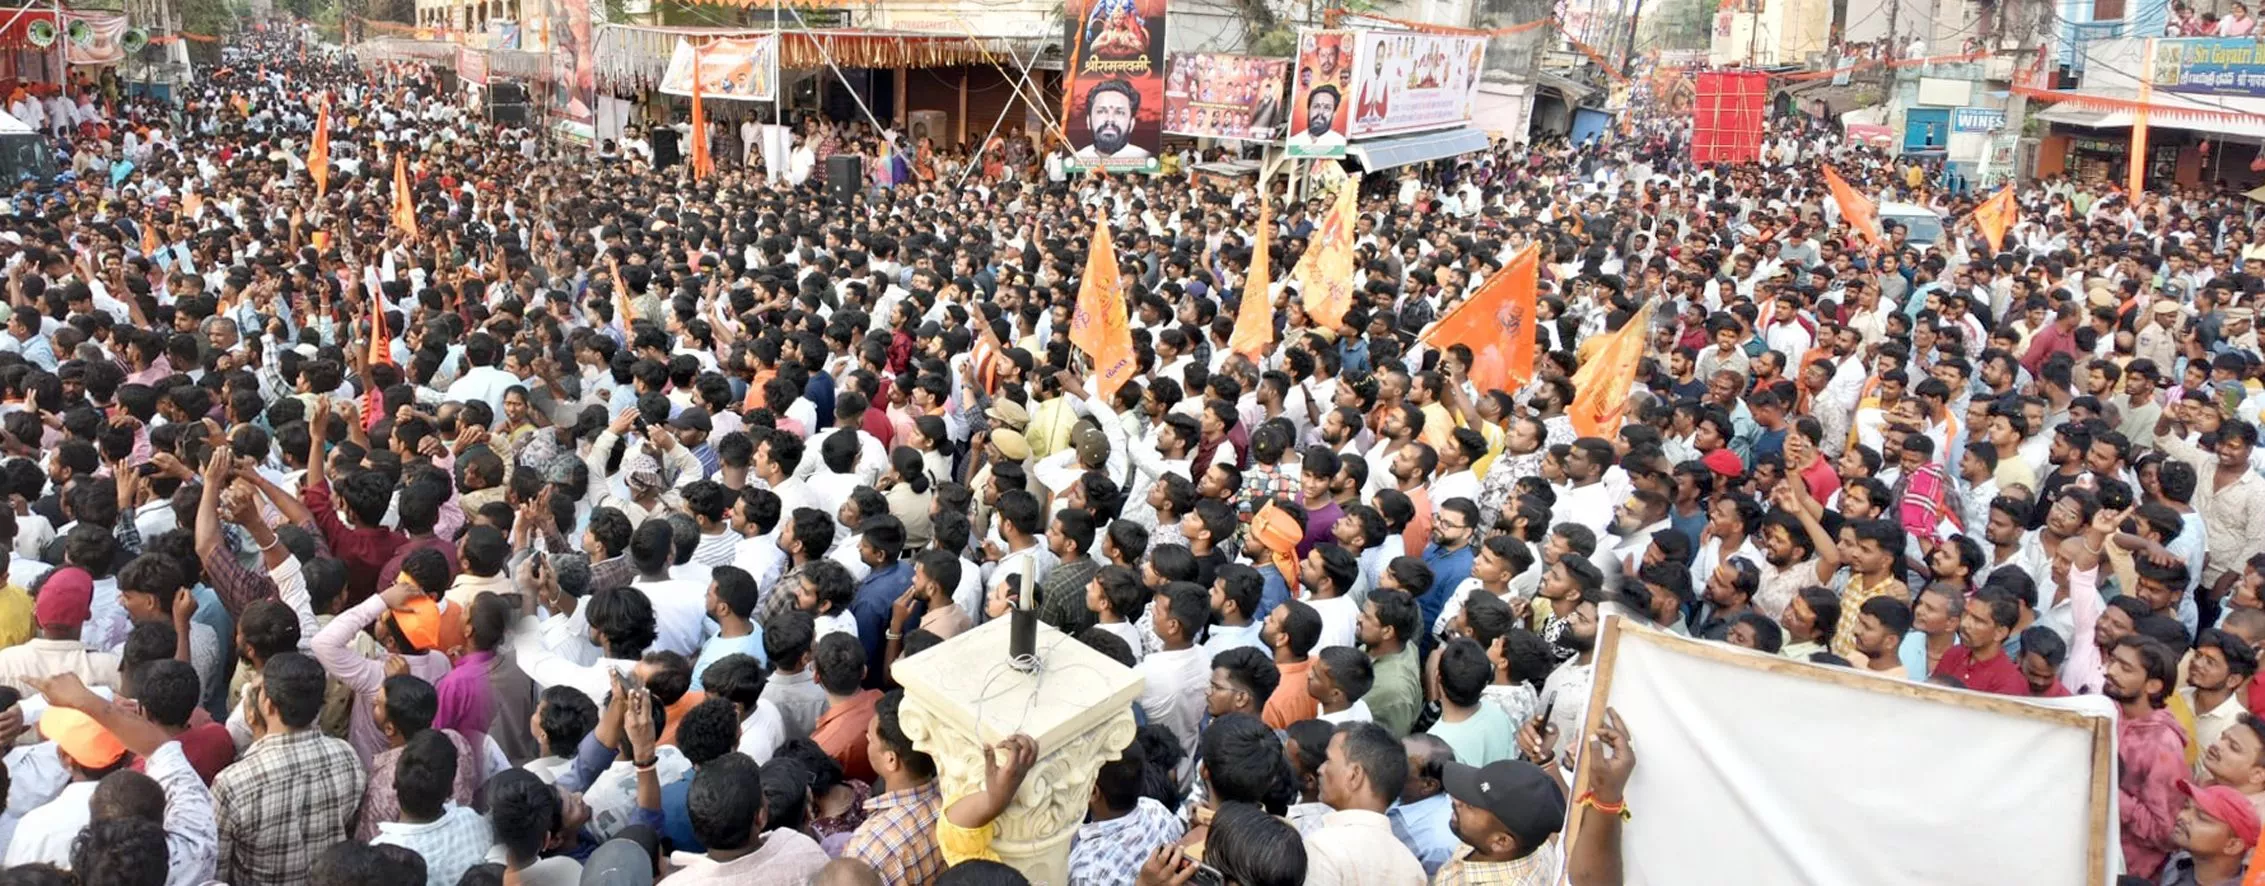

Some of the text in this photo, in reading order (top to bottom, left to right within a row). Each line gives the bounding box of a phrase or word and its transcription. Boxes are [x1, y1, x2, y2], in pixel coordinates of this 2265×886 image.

[2193, 44, 2209, 64] Sri
[2212, 44, 2252, 69] Gayatri
[1958, 115, 2005, 128] WINES
